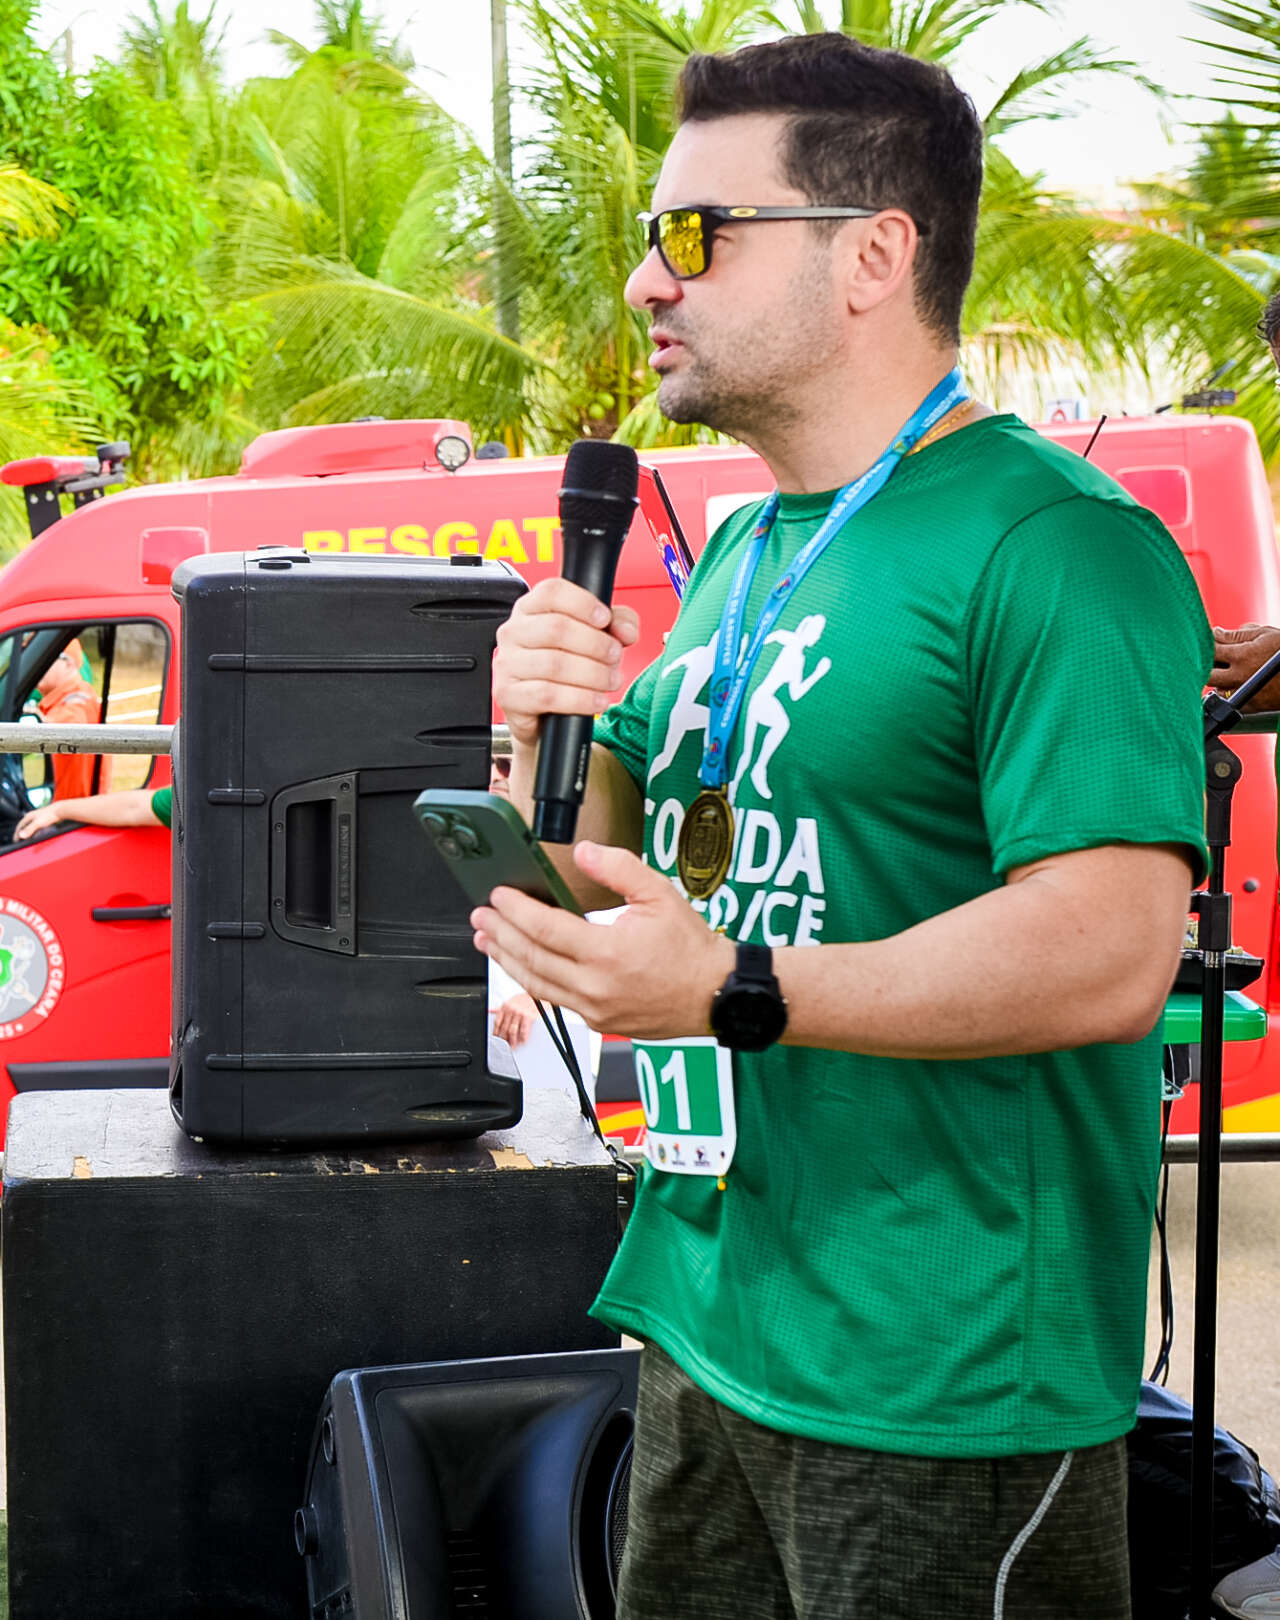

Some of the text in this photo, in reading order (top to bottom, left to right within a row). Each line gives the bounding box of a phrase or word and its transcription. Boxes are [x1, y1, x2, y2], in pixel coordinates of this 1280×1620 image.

[302, 516, 561, 562] RESGAT
[642, 798, 825, 893] OIDA
[5, 899, 56, 944] MILITAR
[47, 943, 64, 966] DO
